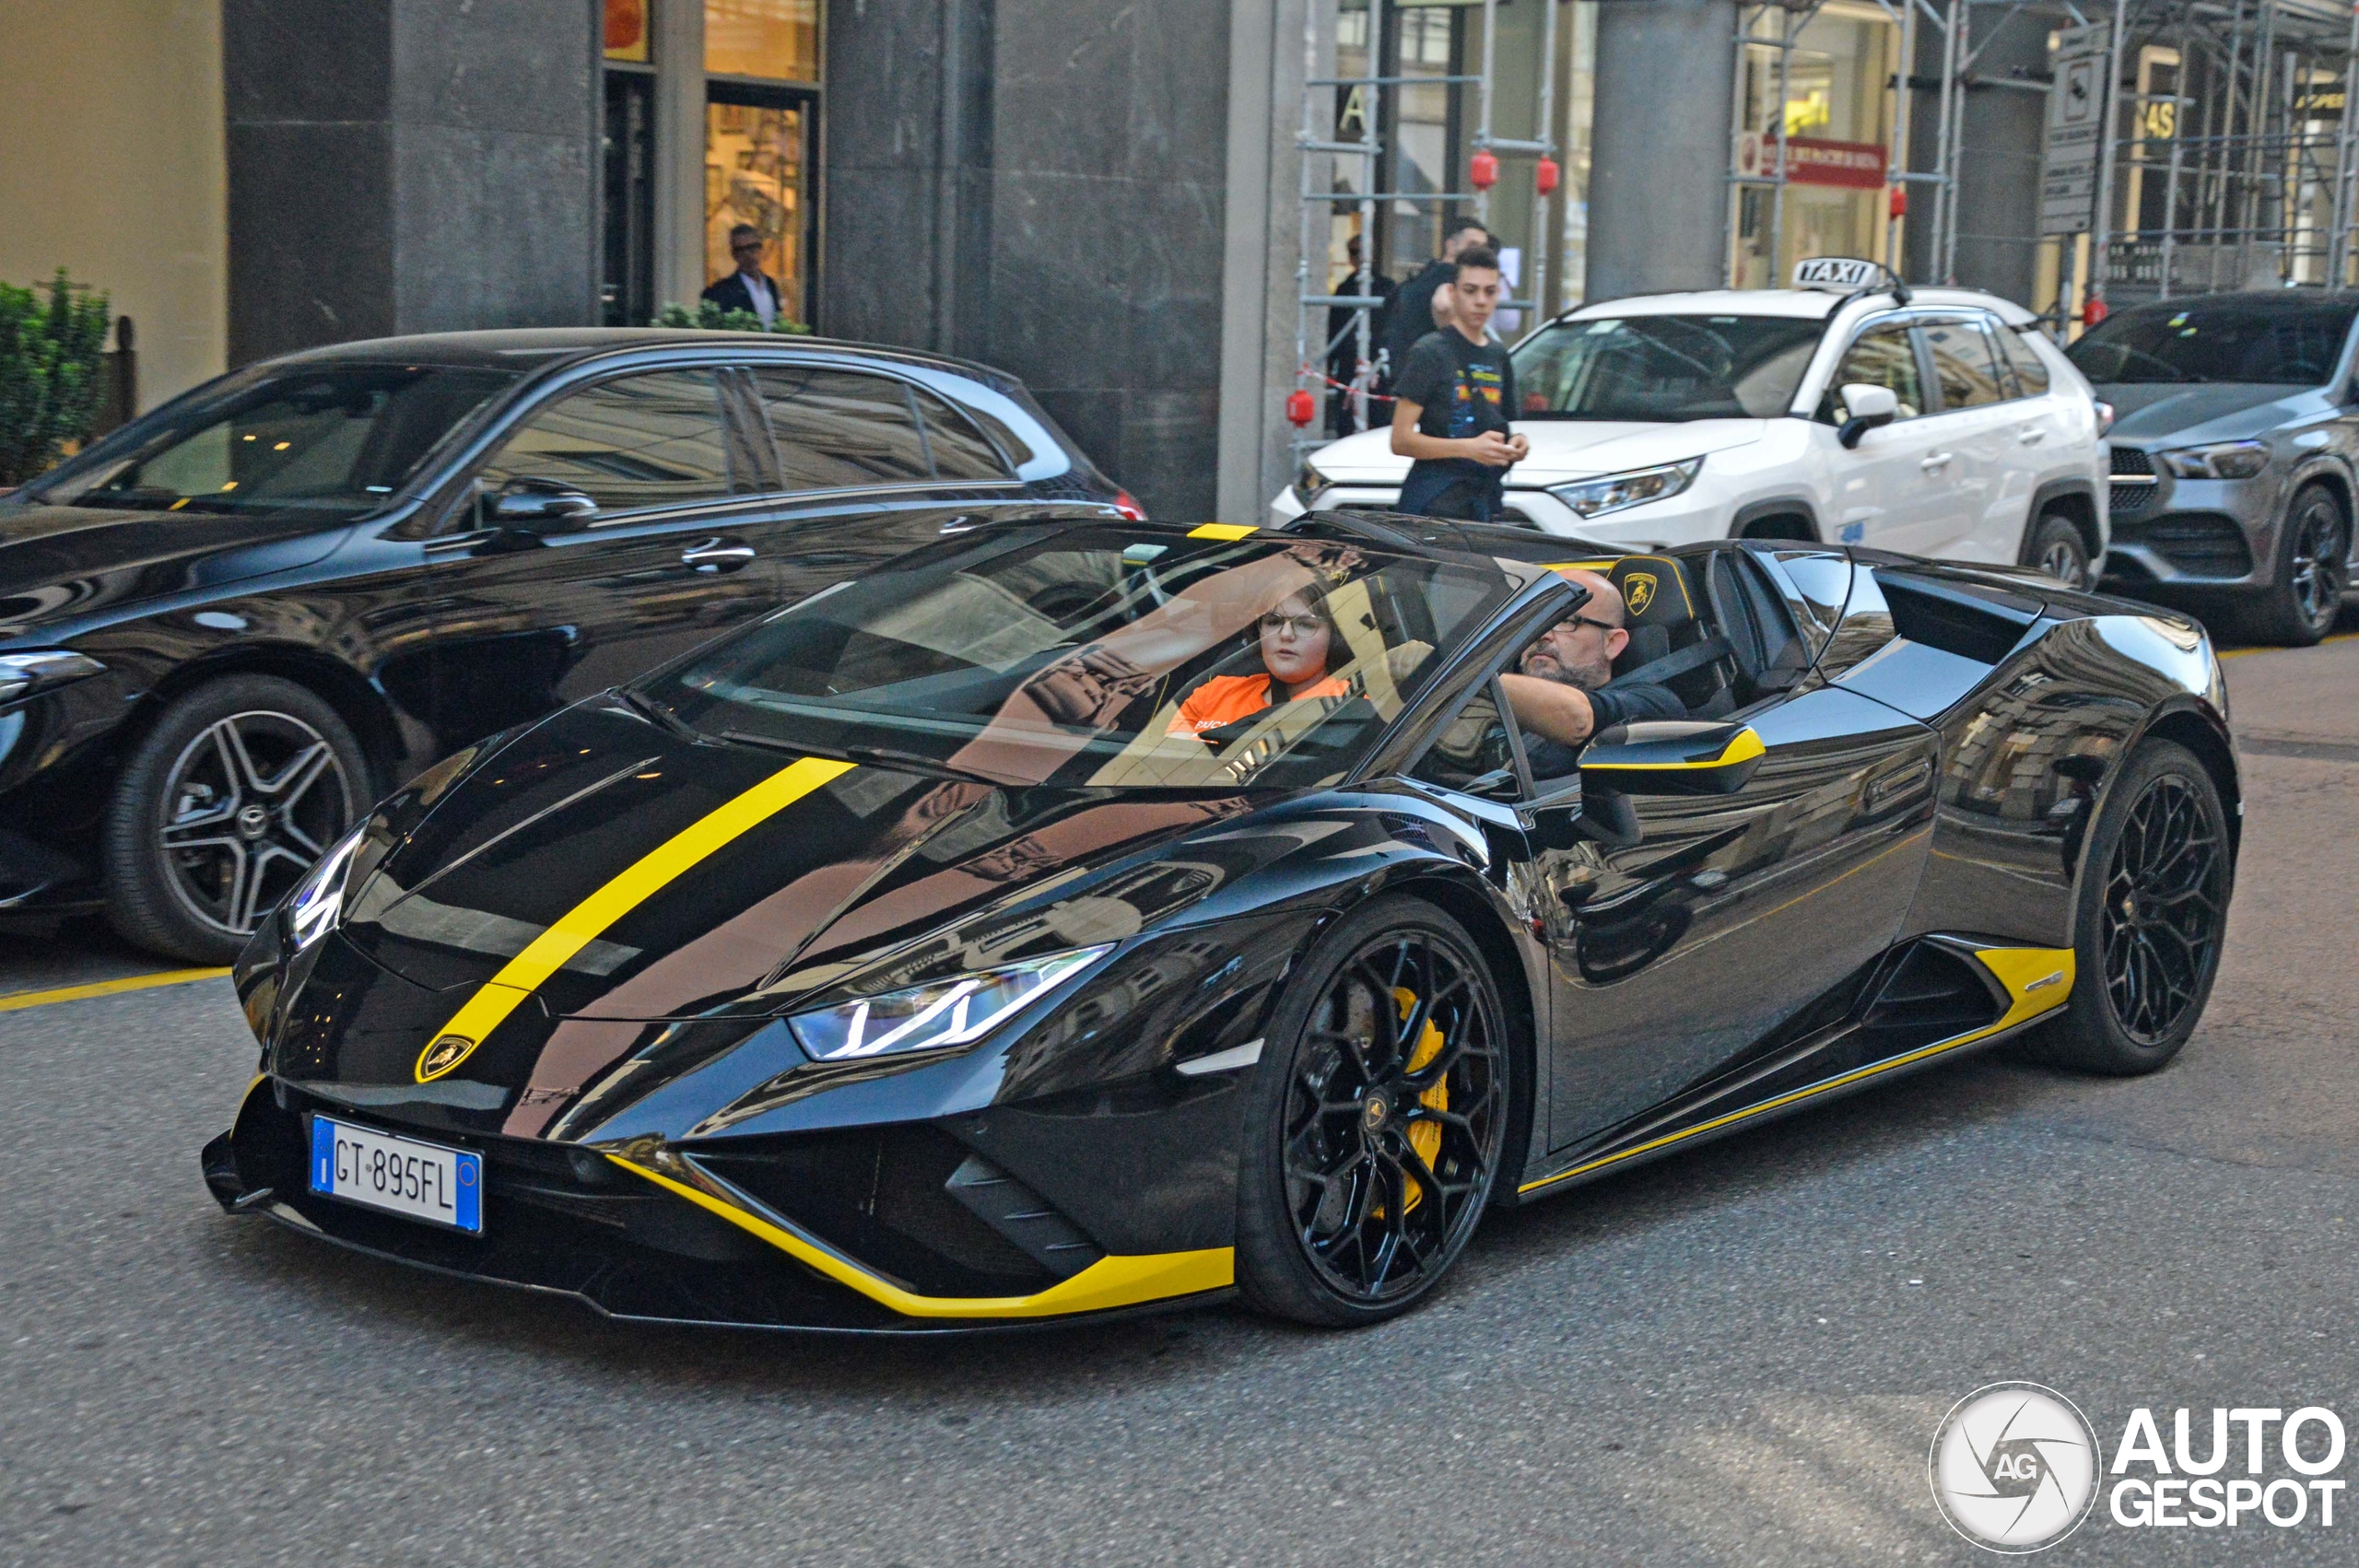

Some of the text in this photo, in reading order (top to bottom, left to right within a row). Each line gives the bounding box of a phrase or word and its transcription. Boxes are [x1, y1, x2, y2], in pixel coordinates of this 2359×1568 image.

[1802, 261, 1865, 284] TAXI
[335, 1139, 364, 1186] GT
[373, 1149, 452, 1209] 895FL
